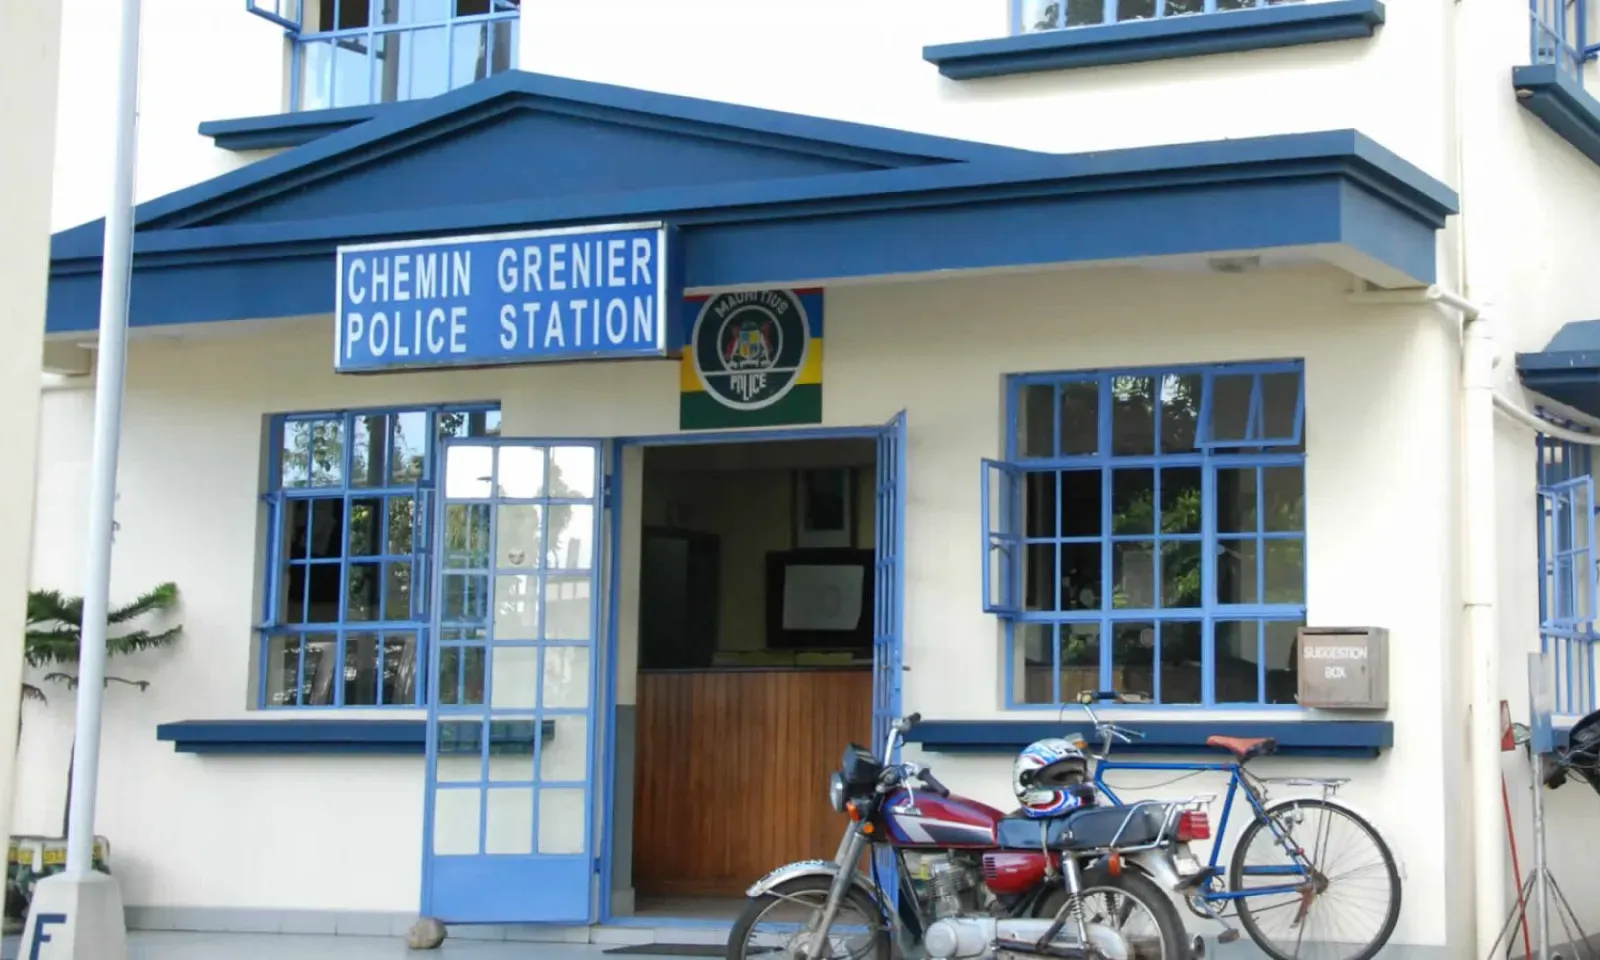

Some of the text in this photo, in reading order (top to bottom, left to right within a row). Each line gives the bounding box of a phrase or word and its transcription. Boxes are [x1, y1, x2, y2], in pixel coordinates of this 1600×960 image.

[348, 238, 652, 303] CHEMIN GRENIER
[346, 296, 653, 359] POLICE STATION
[730, 373, 767, 400] POLICE
[1303, 646, 1367, 659] SUGGESTION
[1324, 666, 1346, 679] BOX
